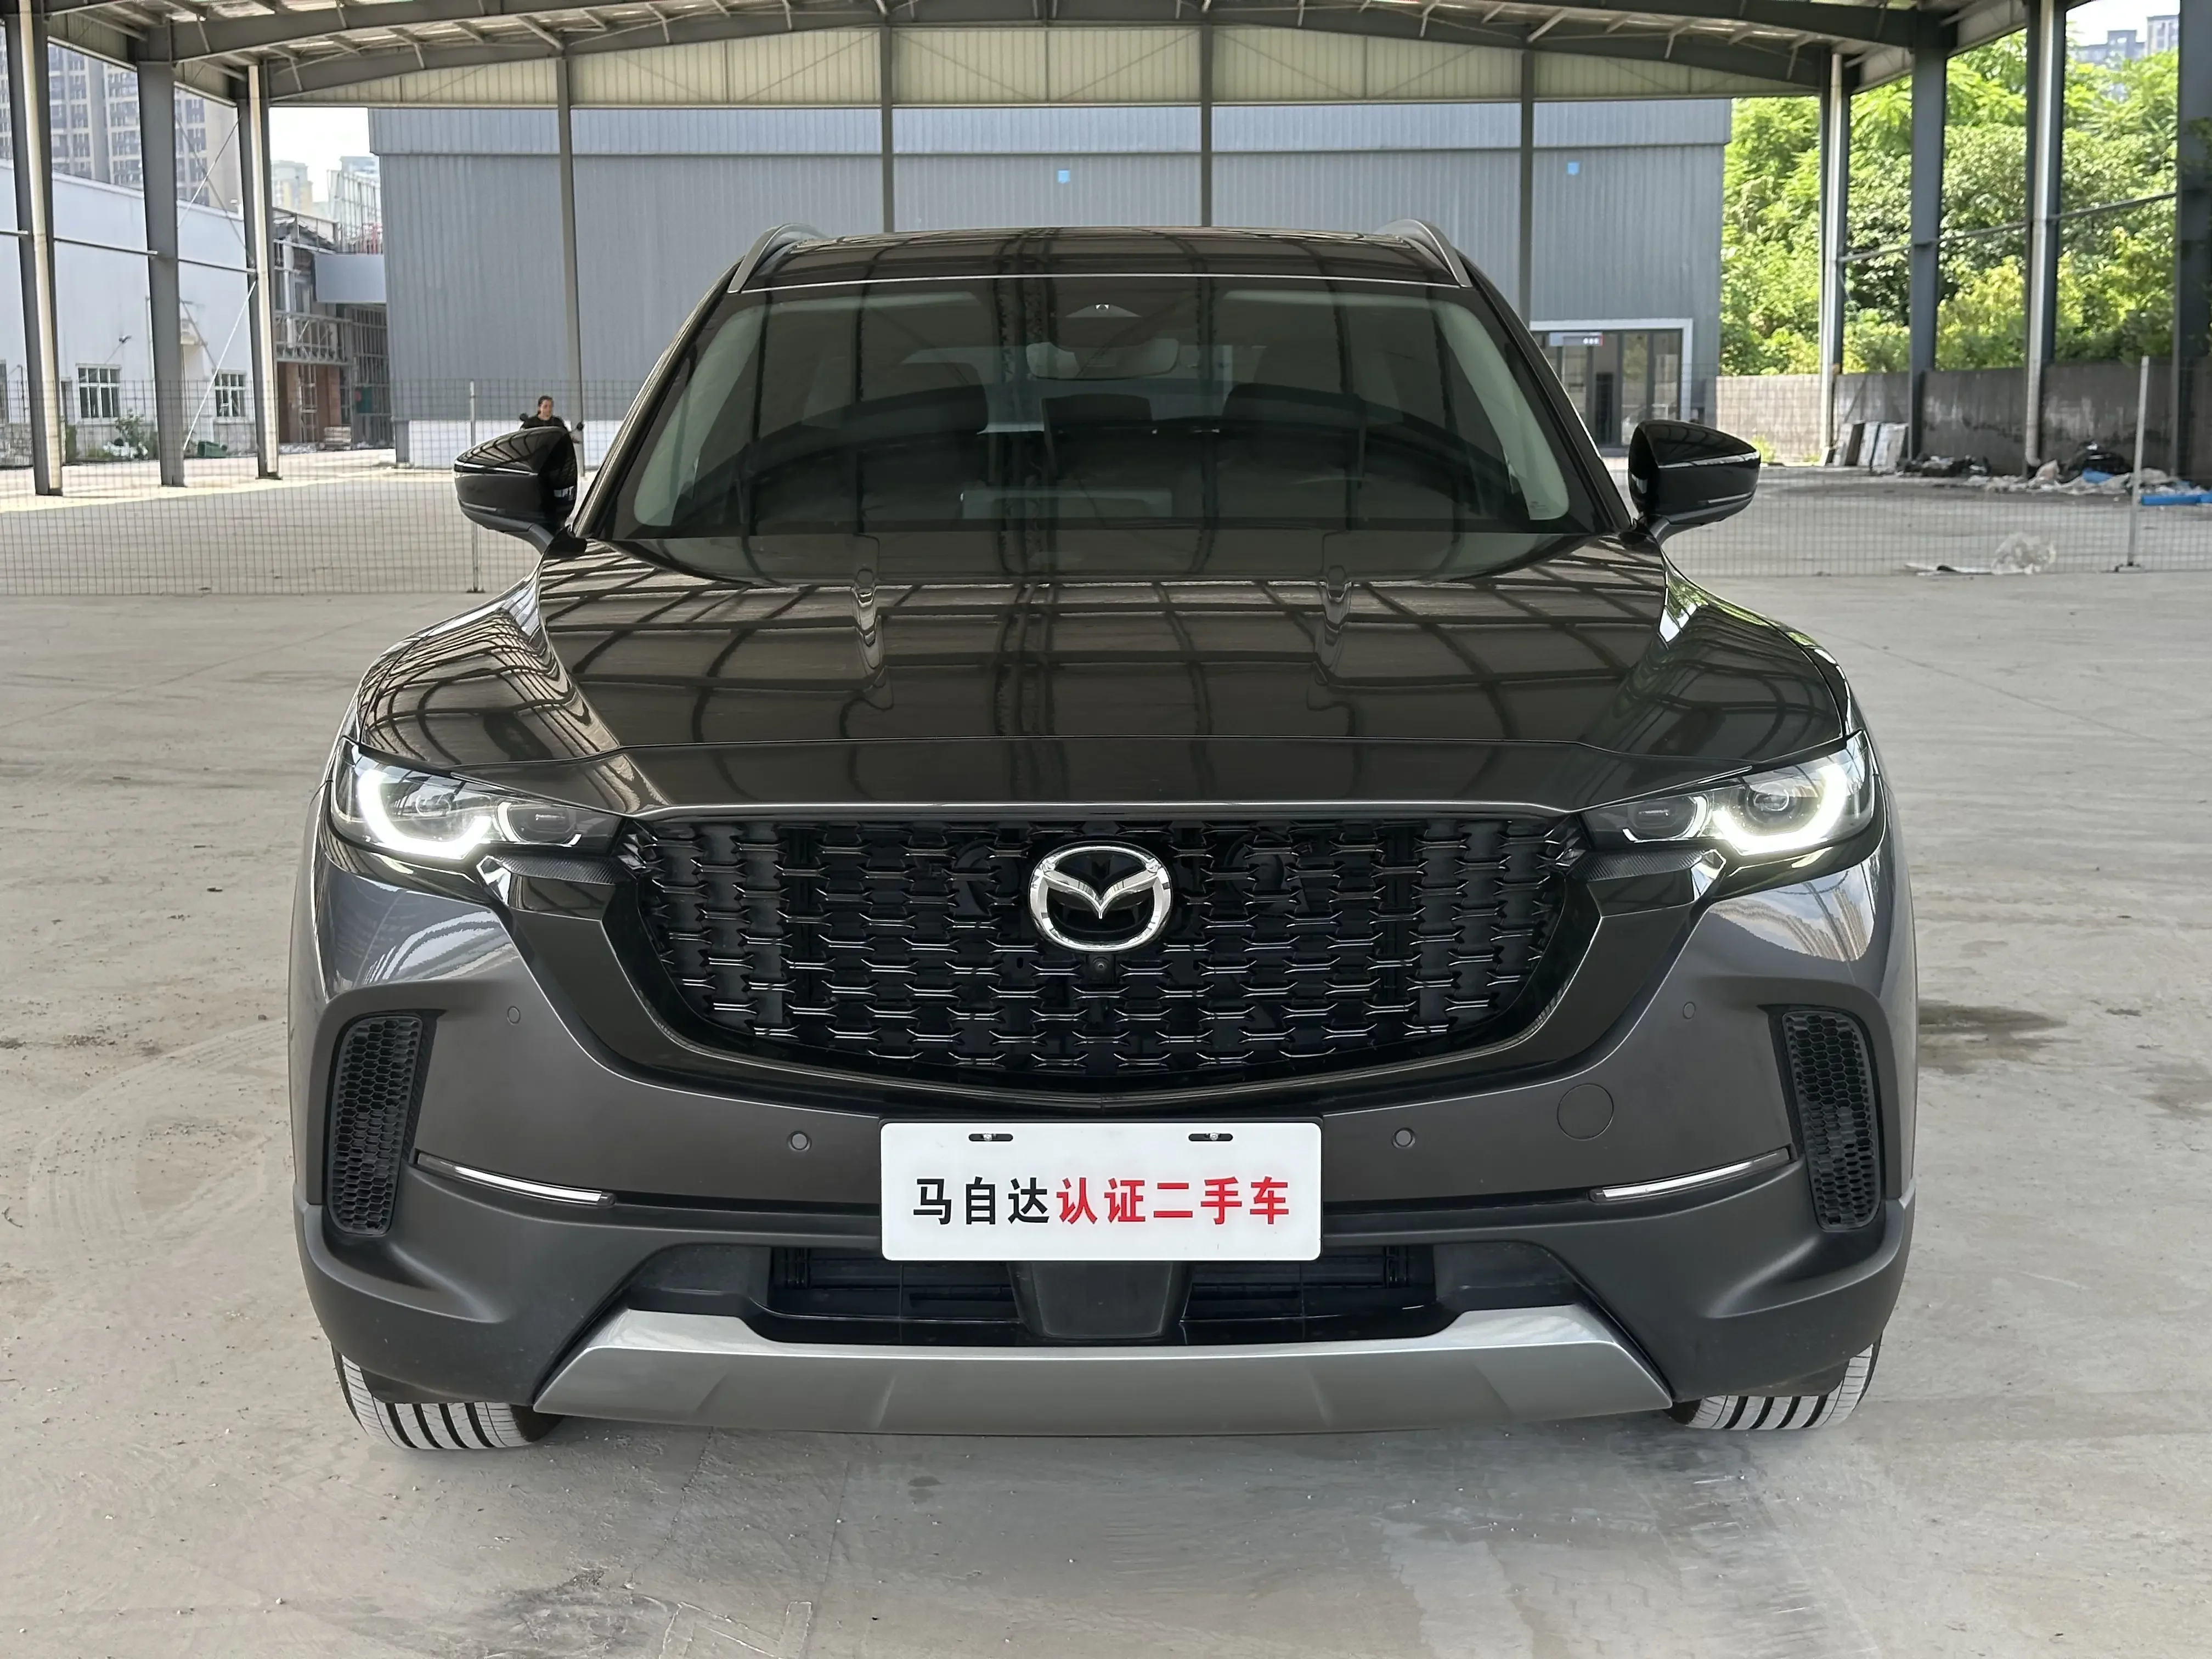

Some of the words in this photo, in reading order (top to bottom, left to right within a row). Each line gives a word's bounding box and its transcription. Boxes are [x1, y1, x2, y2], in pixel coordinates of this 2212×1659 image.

[913, 1176, 1289, 1225] 马自达认证二手车
